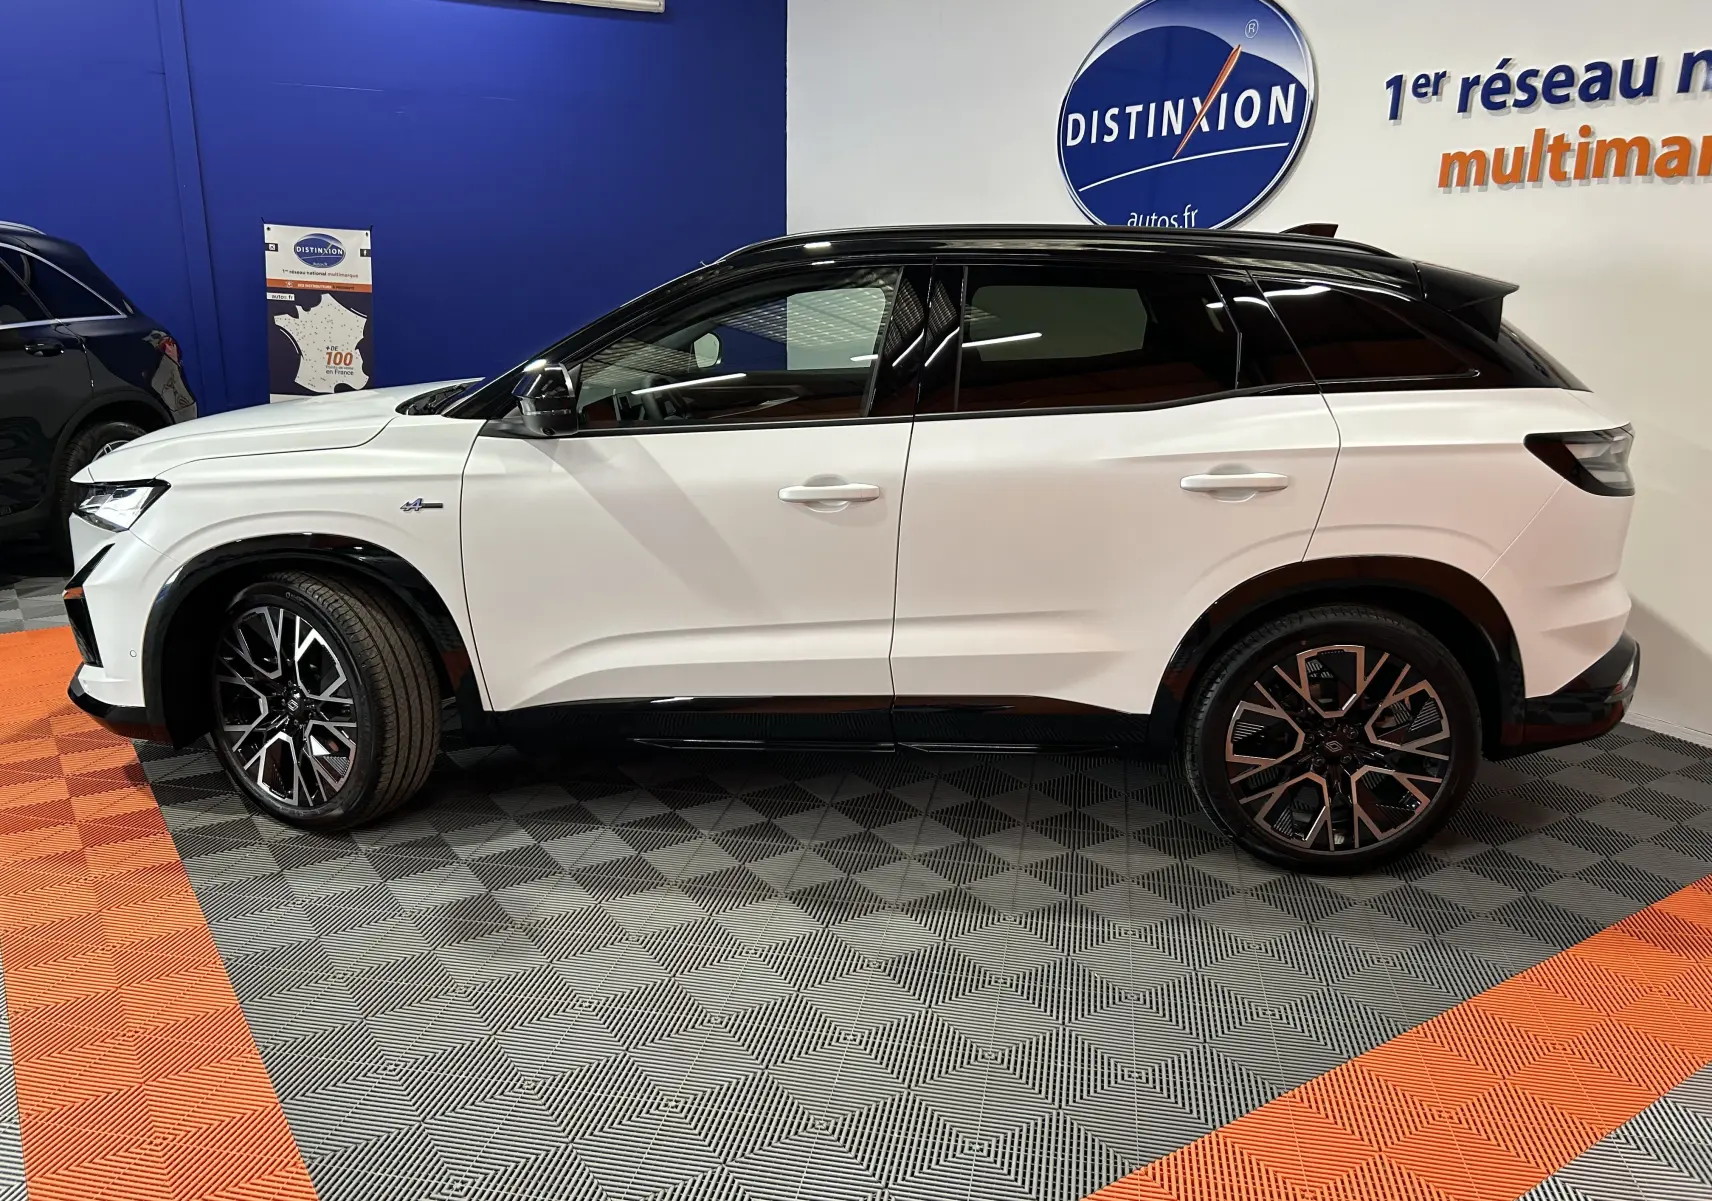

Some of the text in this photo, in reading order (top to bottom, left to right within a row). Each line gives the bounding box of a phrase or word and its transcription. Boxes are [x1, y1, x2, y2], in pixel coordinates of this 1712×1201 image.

[1385, 70, 1448, 121] 1er
[1457, 56, 1660, 114] réseau
[1066, 83, 1296, 147] DISTINXION
[1127, 203, 1199, 229] autos.fr
[296, 245, 344, 256] DISTINXION
[326, 351, 353, 366] 100
